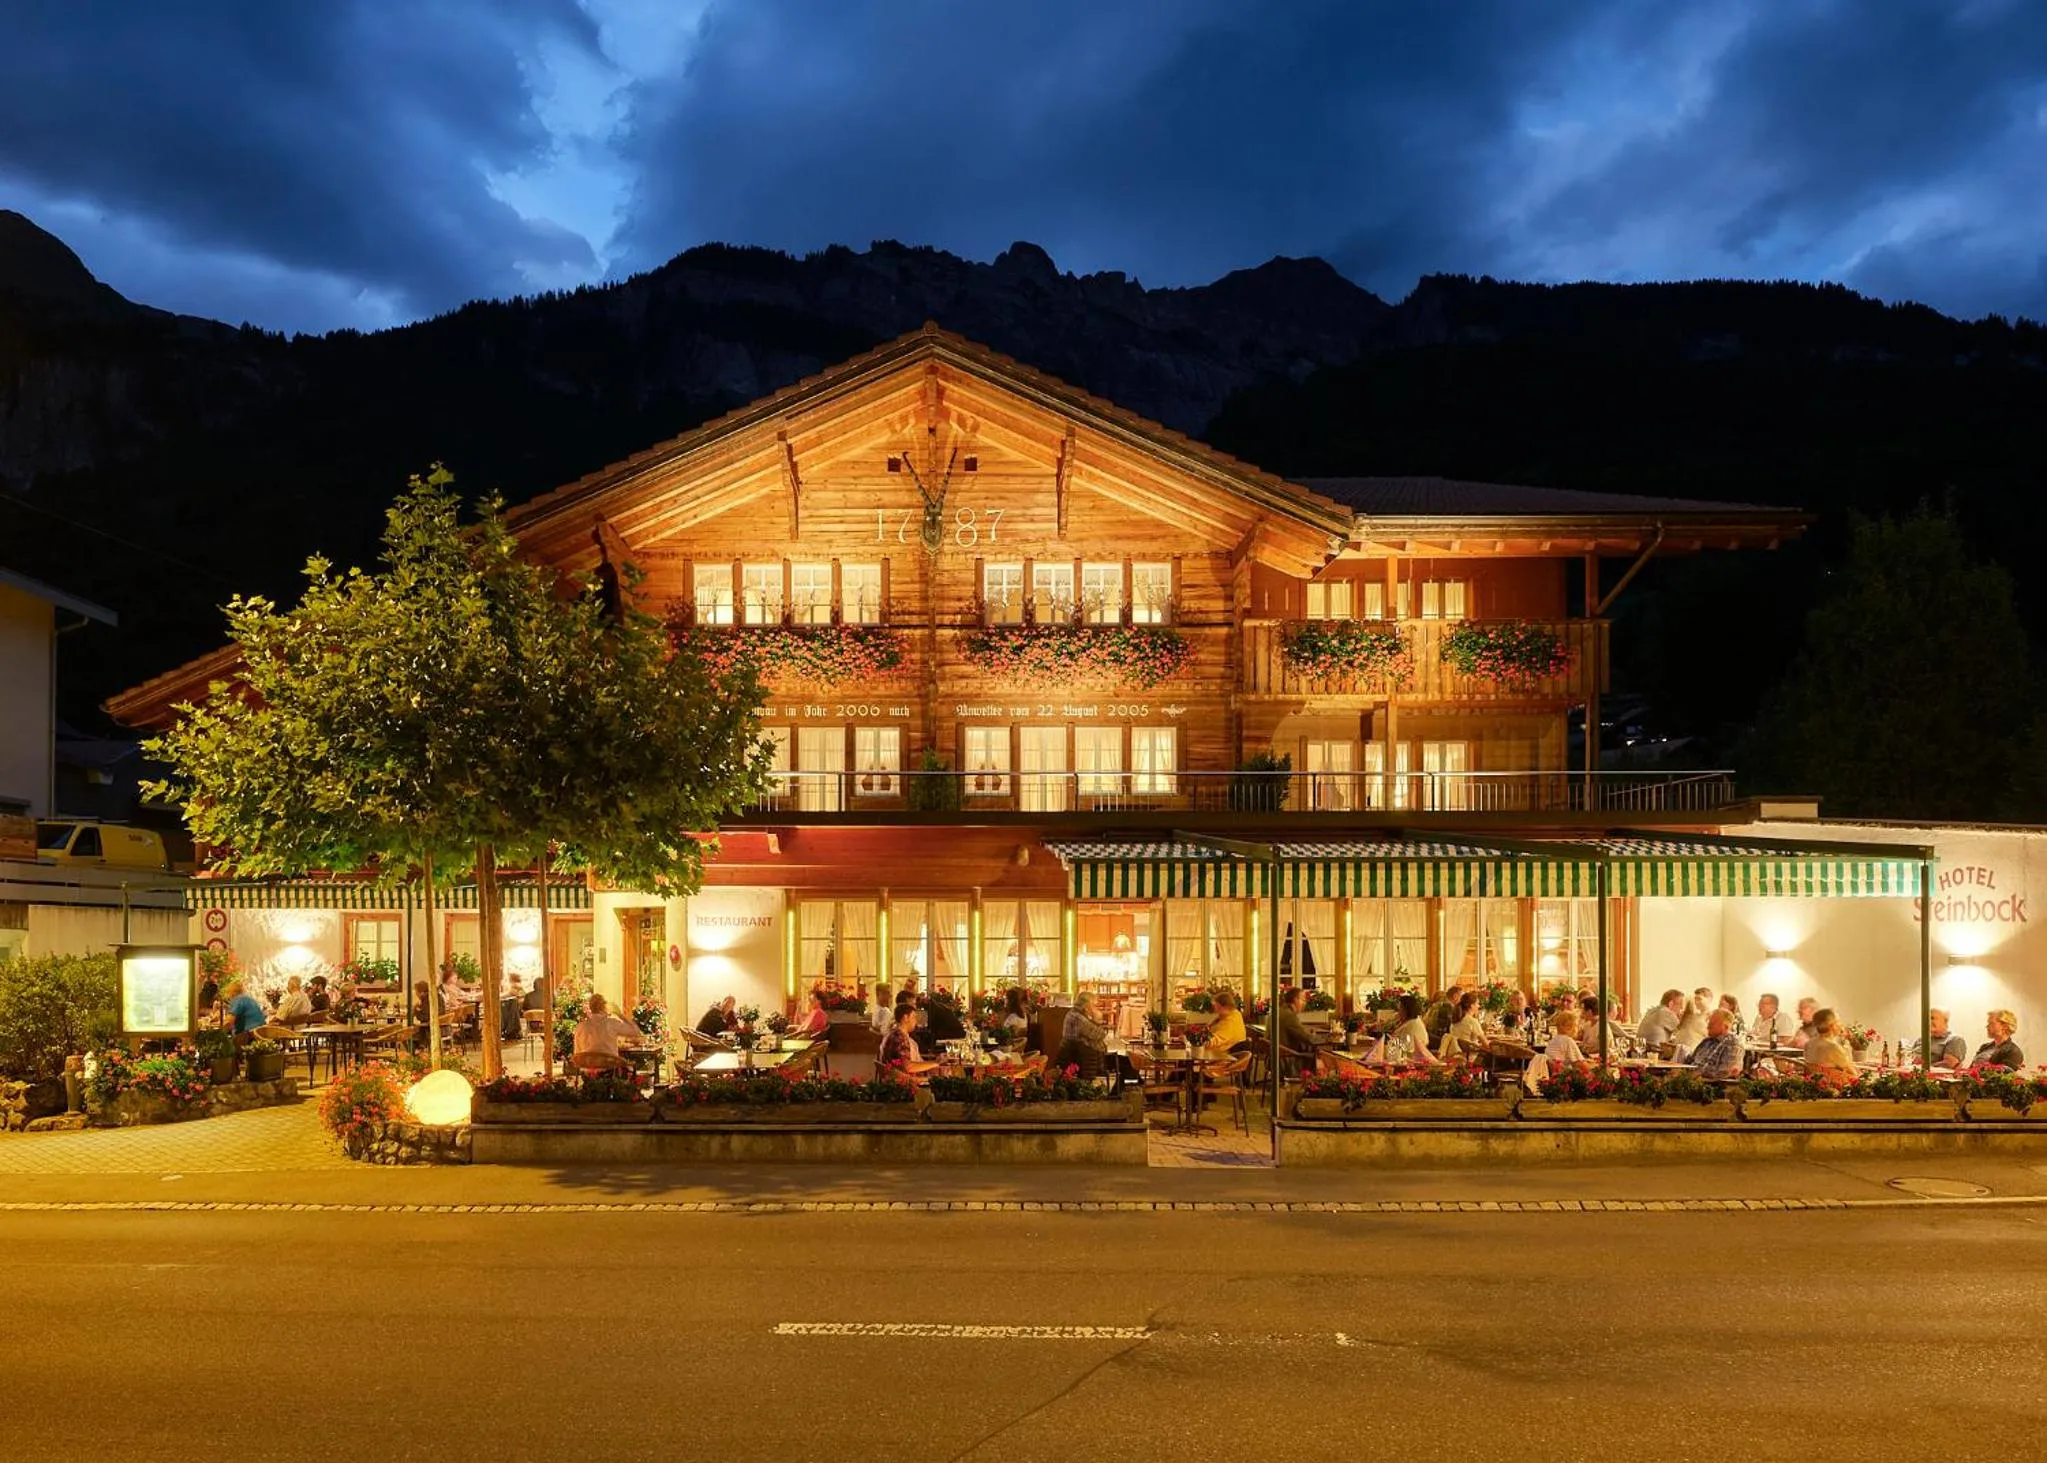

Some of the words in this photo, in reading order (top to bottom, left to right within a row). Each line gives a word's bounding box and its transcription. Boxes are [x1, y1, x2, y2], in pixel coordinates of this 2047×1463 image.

[876, 508, 913, 544] 17
[955, 507, 1006, 548] 87
[784, 704, 797, 717] im
[836, 704, 881, 717] 2006
[889, 705, 910, 718] nach
[1062, 704, 1098, 718] August
[1107, 704, 1149, 717] 2005
[1939, 866, 1996, 891] HOTEL
[1912, 893, 2028, 923] Seinbock
[696, 916, 773, 927] RESTAURANT
